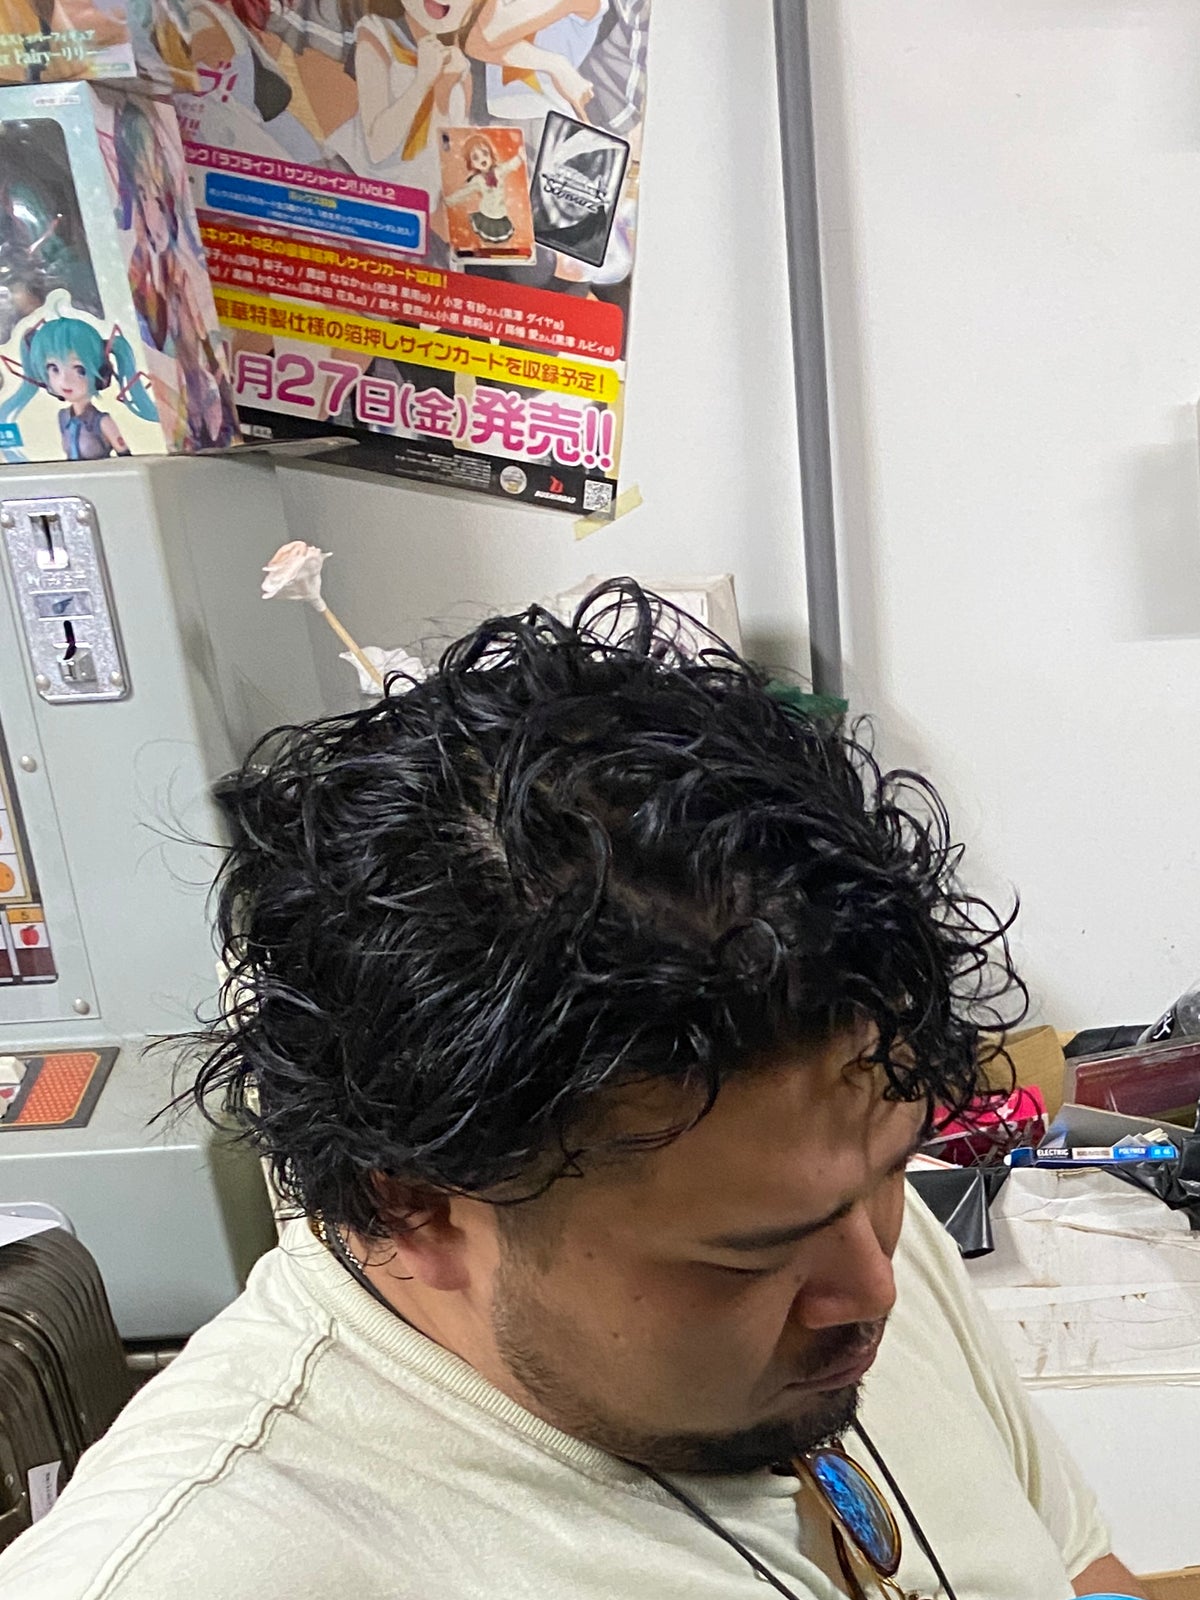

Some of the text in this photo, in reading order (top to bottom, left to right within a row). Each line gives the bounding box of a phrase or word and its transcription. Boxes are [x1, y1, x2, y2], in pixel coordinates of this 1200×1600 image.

[222, 340, 613, 468] 月27日(金)発売!!
[1037, 1148, 1069, 1157] ELECTRIC
